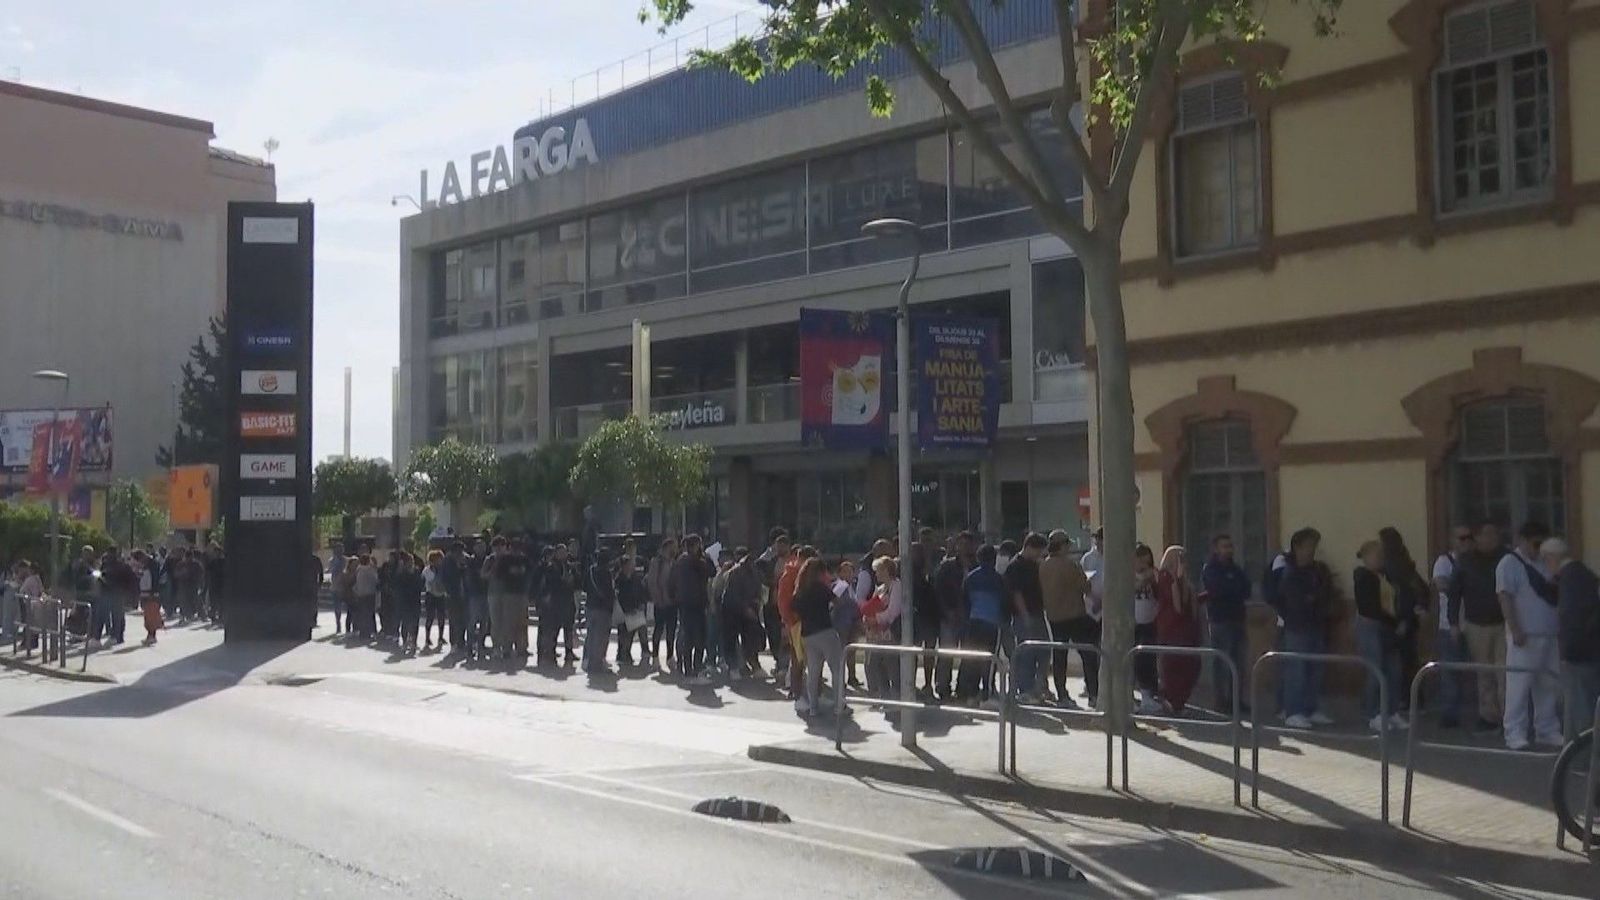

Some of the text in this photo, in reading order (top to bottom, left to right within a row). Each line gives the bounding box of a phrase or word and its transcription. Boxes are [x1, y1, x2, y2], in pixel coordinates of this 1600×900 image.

[421, 118, 599, 212] LA FARGA
[256, 336, 291, 345] CINESA
[935, 379, 985, 396] LITATS
[241, 413, 295, 430] BASIC-FIT
[937, 415, 984, 432] SANIA
[251, 461, 287, 473] GAME
